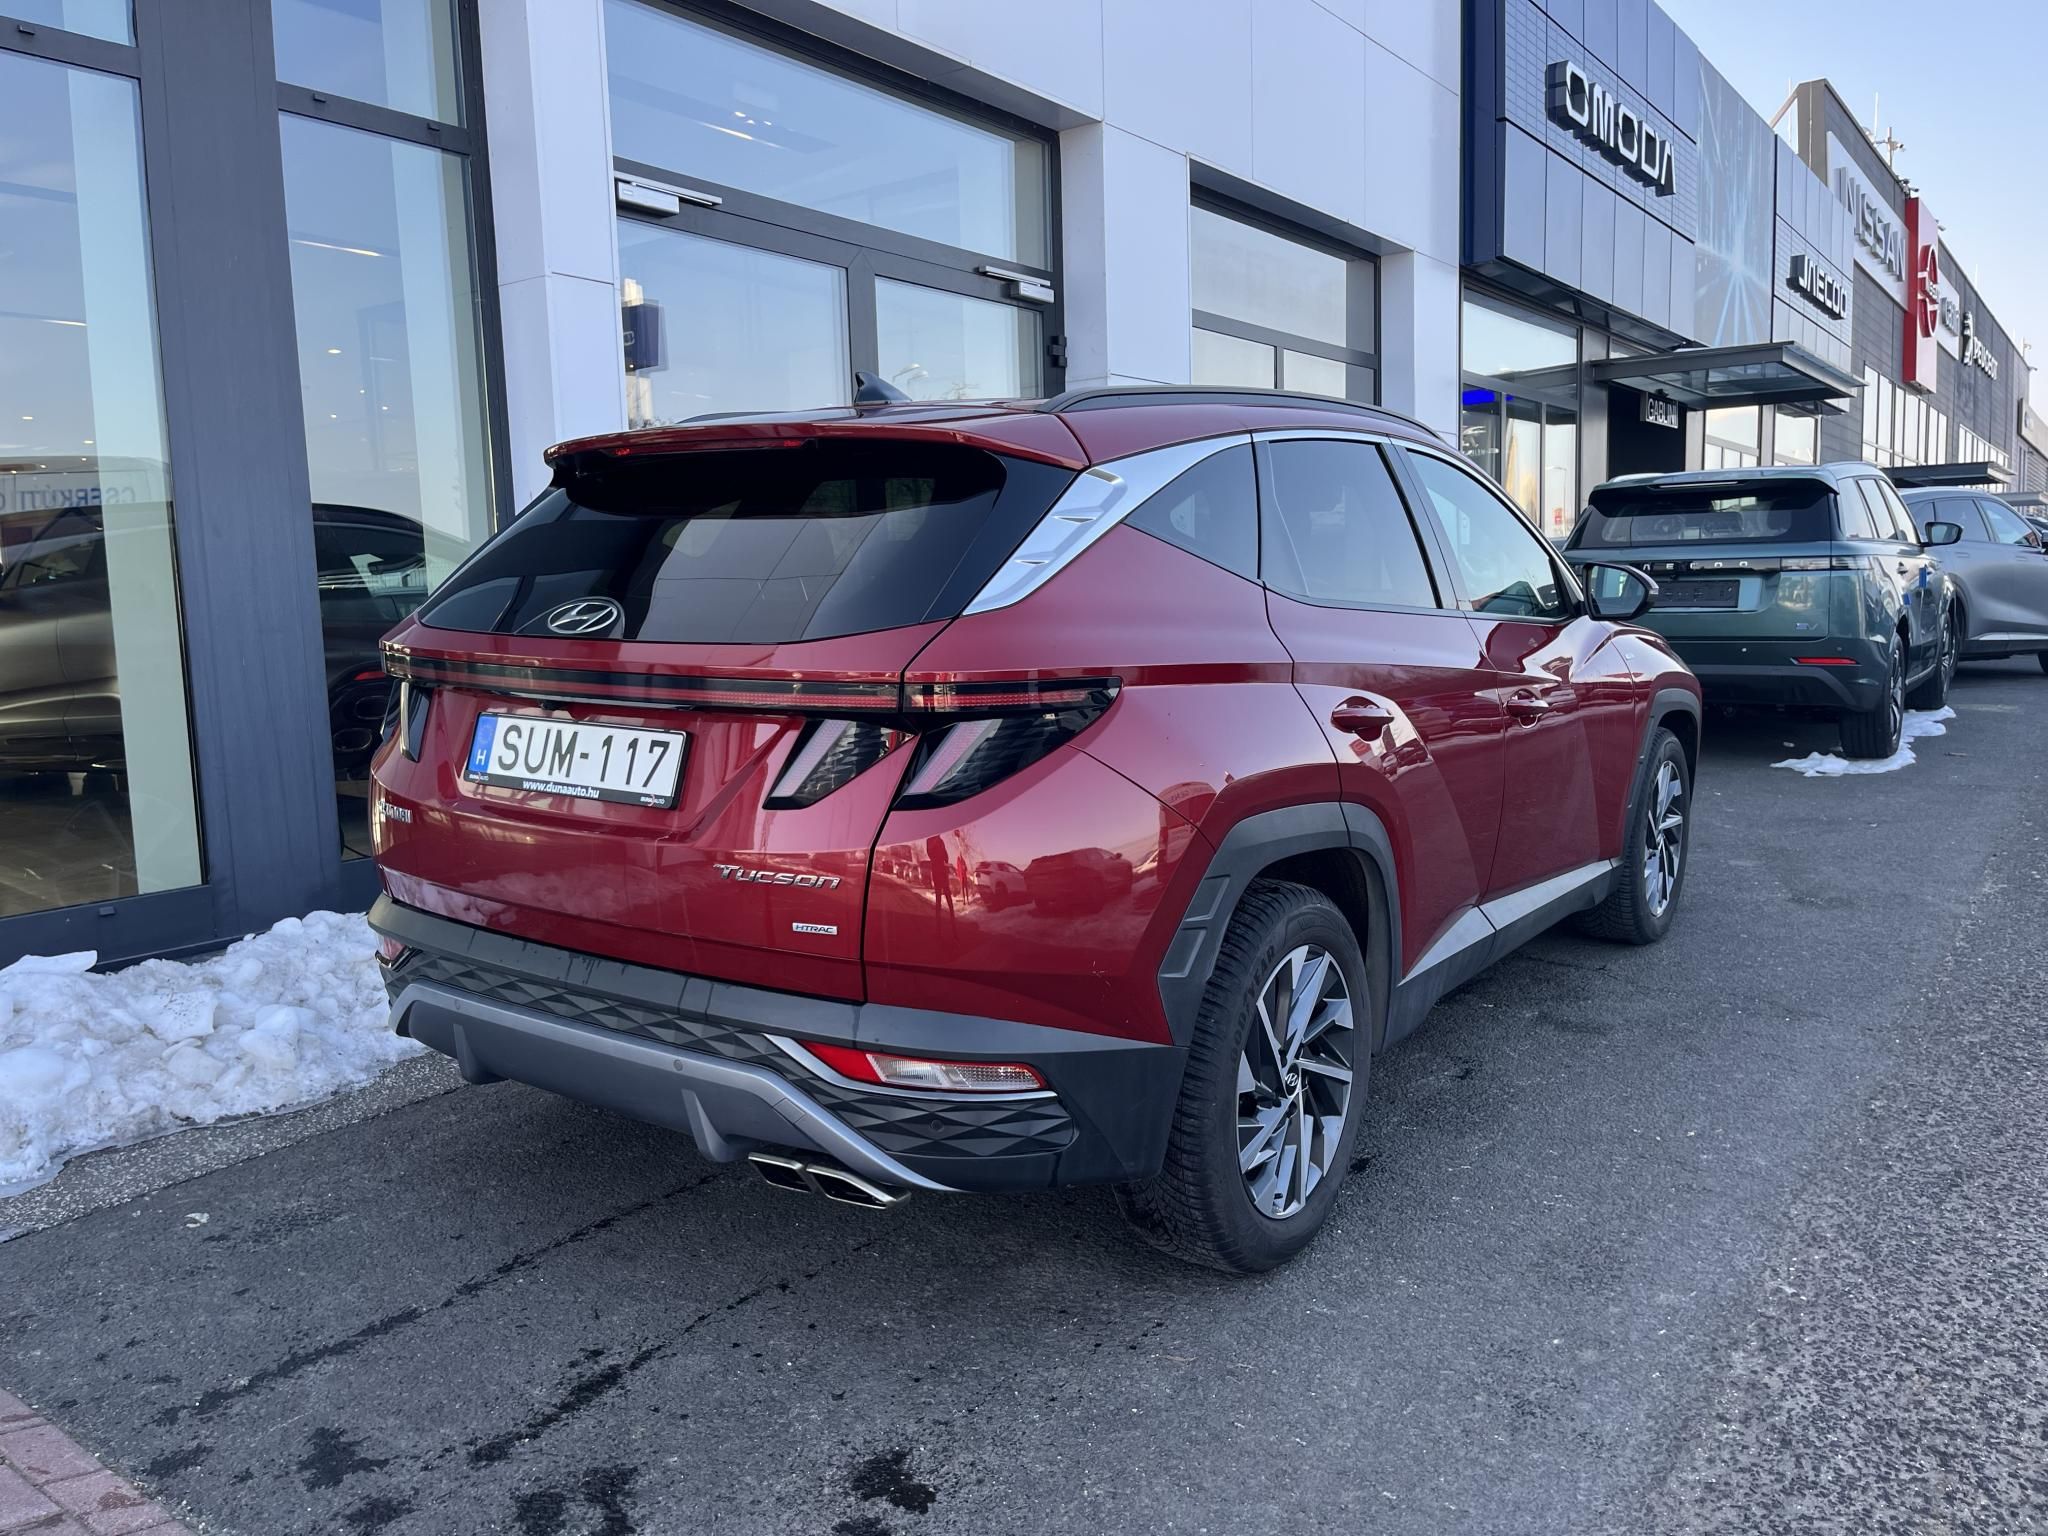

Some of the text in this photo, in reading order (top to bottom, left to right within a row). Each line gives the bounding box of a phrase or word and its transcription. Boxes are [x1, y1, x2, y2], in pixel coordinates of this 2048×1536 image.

[1564, 60, 1677, 195] OMODA
[1836, 167, 1906, 282] NISSAN
[1797, 254, 1848, 319] JAECOO
[1647, 398, 1678, 426] GABLINI
[1642, 561, 1748, 571] AECOO
[475, 749, 486, 766] H
[497, 724, 671, 788] SUM-117
[522, 779, 600, 799] www.dunaauto.hu
[795, 924, 834, 933] HTRAC
